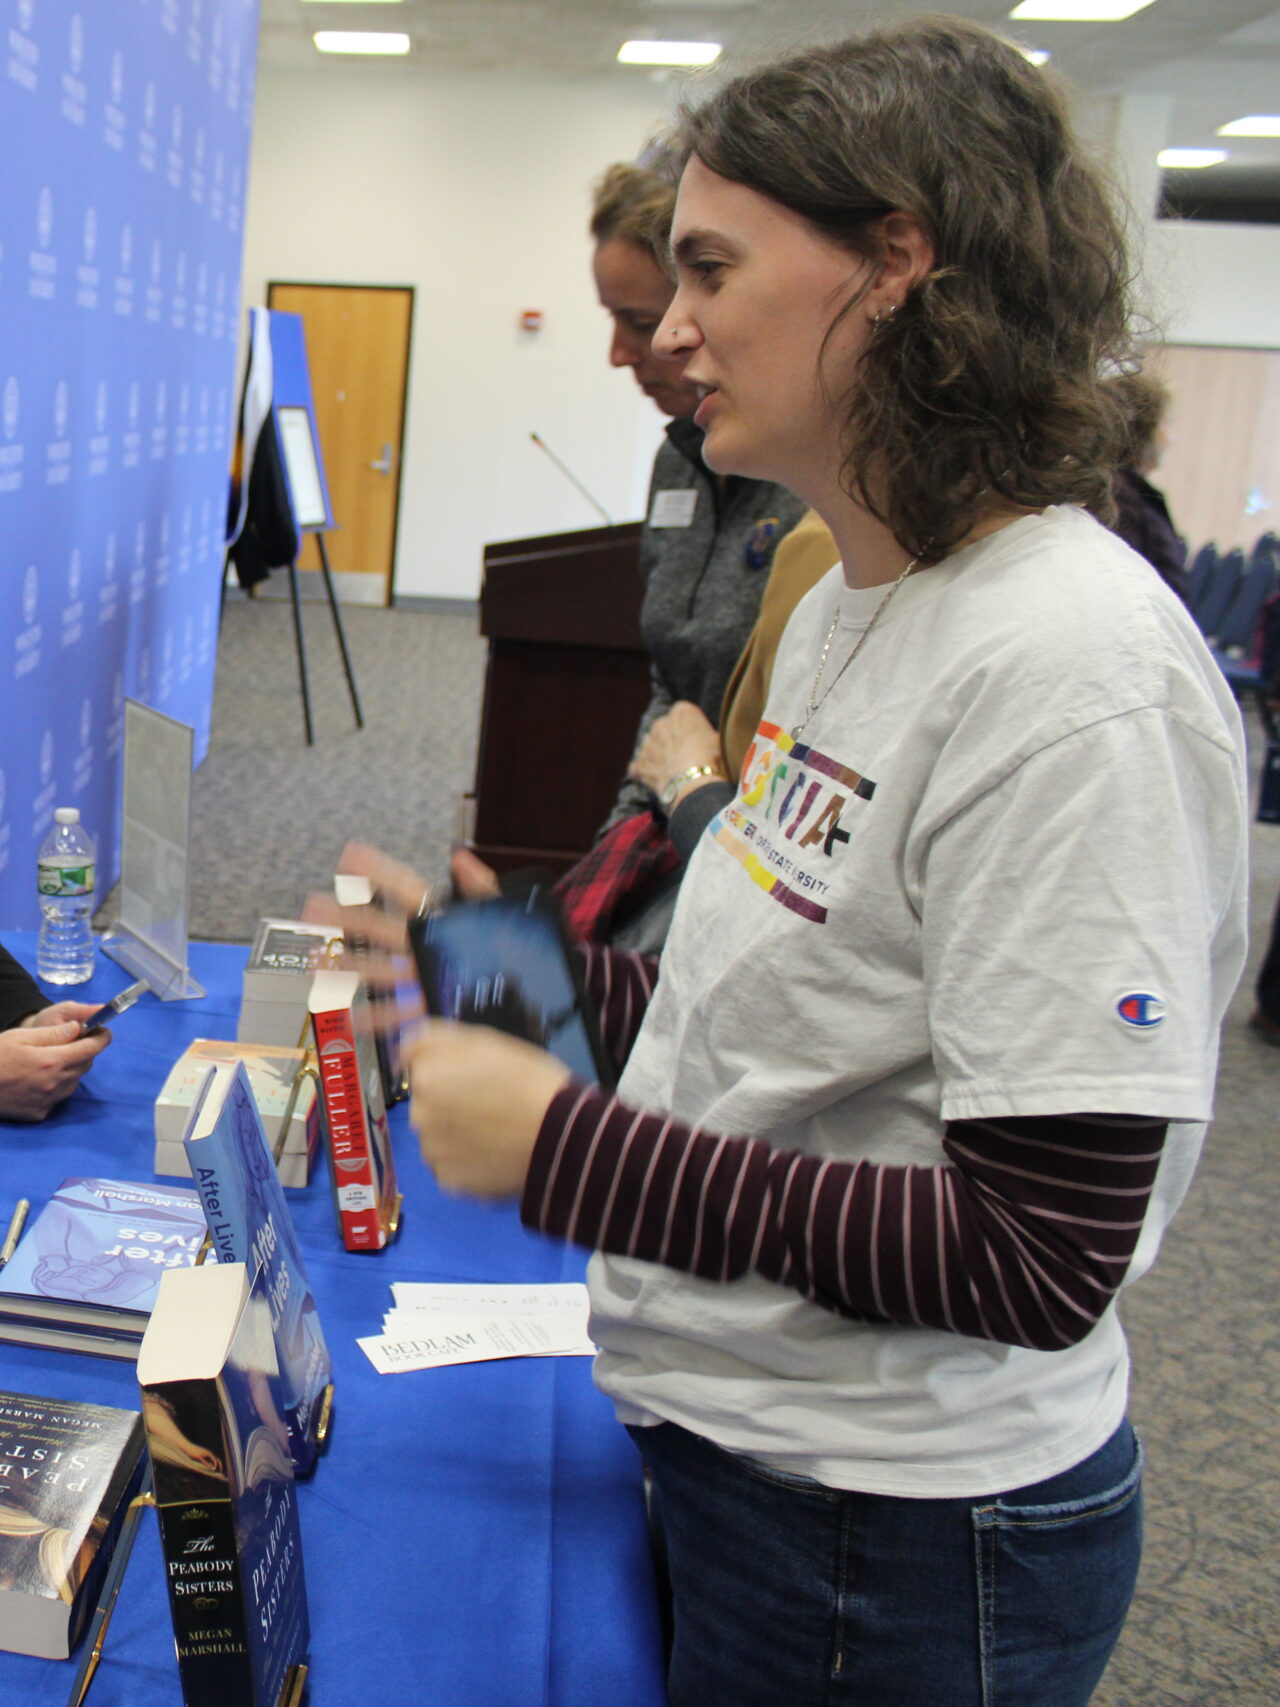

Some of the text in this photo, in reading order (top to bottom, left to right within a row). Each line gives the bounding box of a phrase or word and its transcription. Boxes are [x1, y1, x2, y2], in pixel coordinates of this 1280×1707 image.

[768, 849, 792, 873] STATE
[323, 1058, 352, 1154] FULLER
[343, 1056, 366, 1152] MARGARET
[94, 1189, 172, 1208] Marshall
[197, 1167, 236, 1263] After Live
[117, 1229, 202, 1251] ives
[252, 1211, 278, 1275] After
[268, 1260, 291, 1334] Lives
[380, 1333, 478, 1357] BEDLAM
[51, 1416, 102, 1430] MEGAN
[182, 1535, 215, 1554] The
[252, 1485, 291, 1606] PEABODY
[169, 1560, 234, 1576] PEABODY
[175, 1581, 234, 1596] SISTERS
[260, 1532, 296, 1643] SISTERS
[188, 1628, 232, 1641] MEGAN
[178, 1642, 247, 1658] MARSHALL
